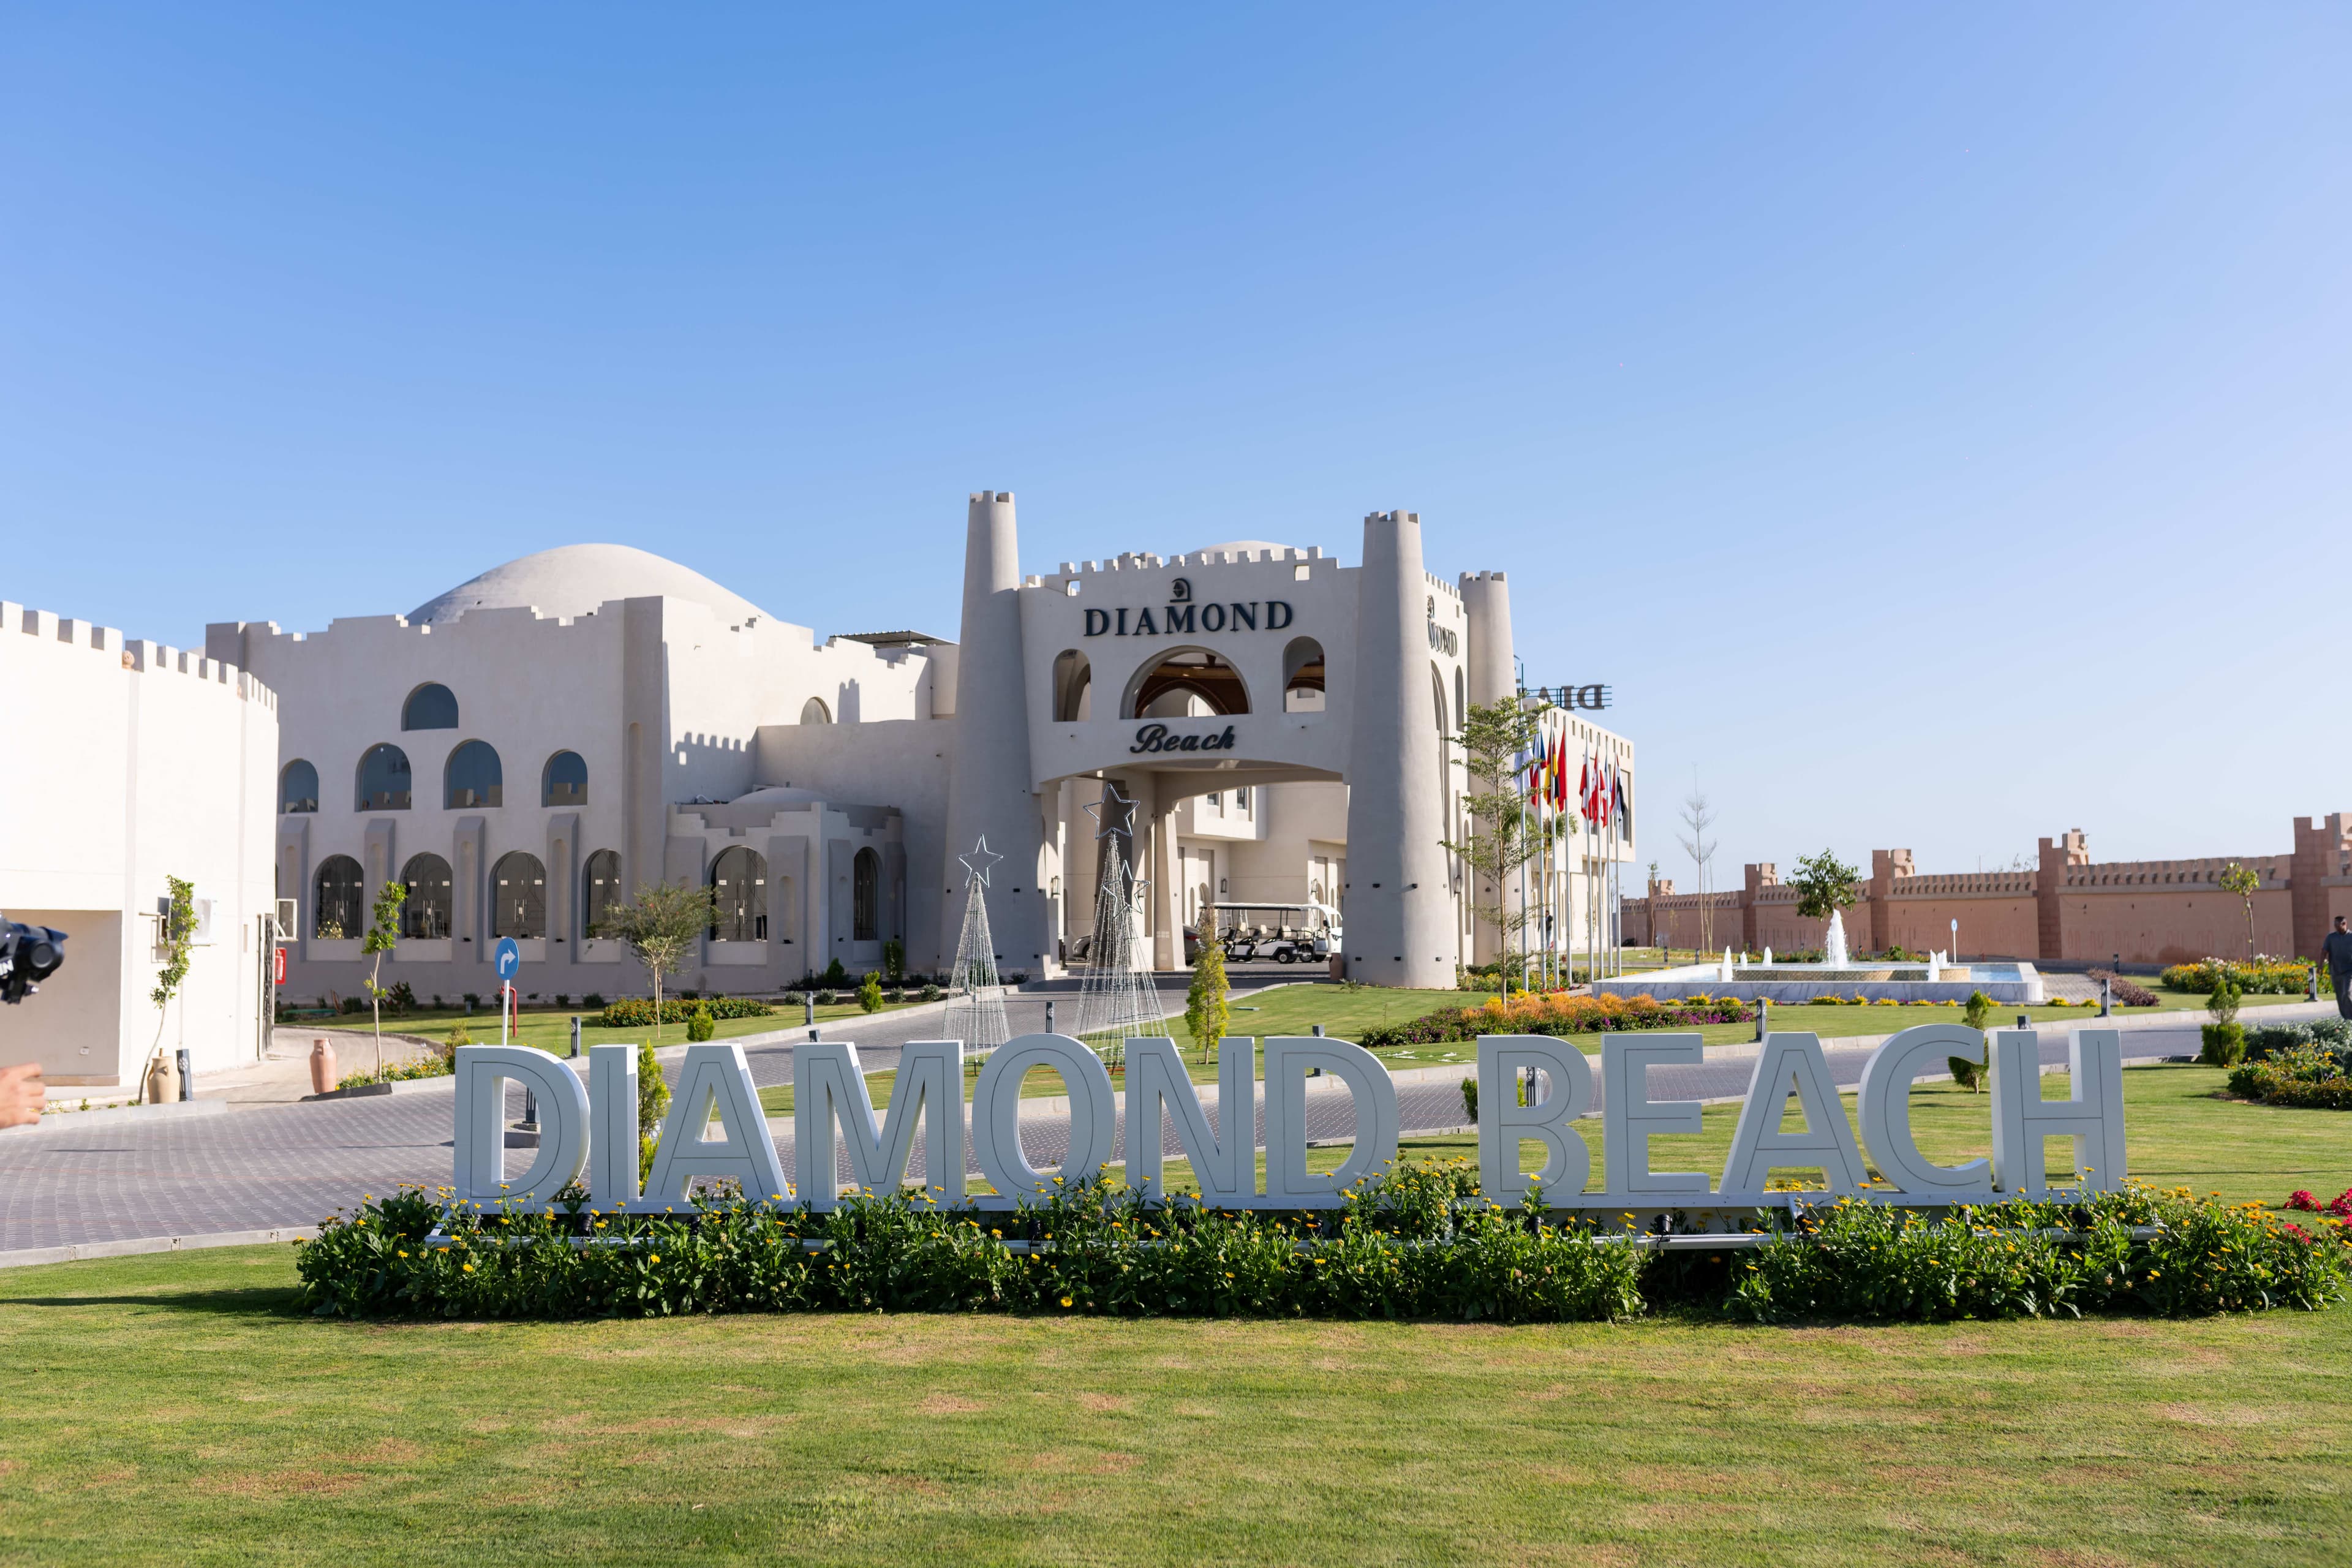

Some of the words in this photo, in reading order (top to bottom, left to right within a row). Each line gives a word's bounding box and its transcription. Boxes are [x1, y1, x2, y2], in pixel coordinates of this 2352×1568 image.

[1083, 601, 1294, 637] DIAMOND
[1129, 723, 1235, 754] Beach
[453, 1033, 1400, 1202] DIAMOND
[1476, 1023, 2127, 1195] BEACH
